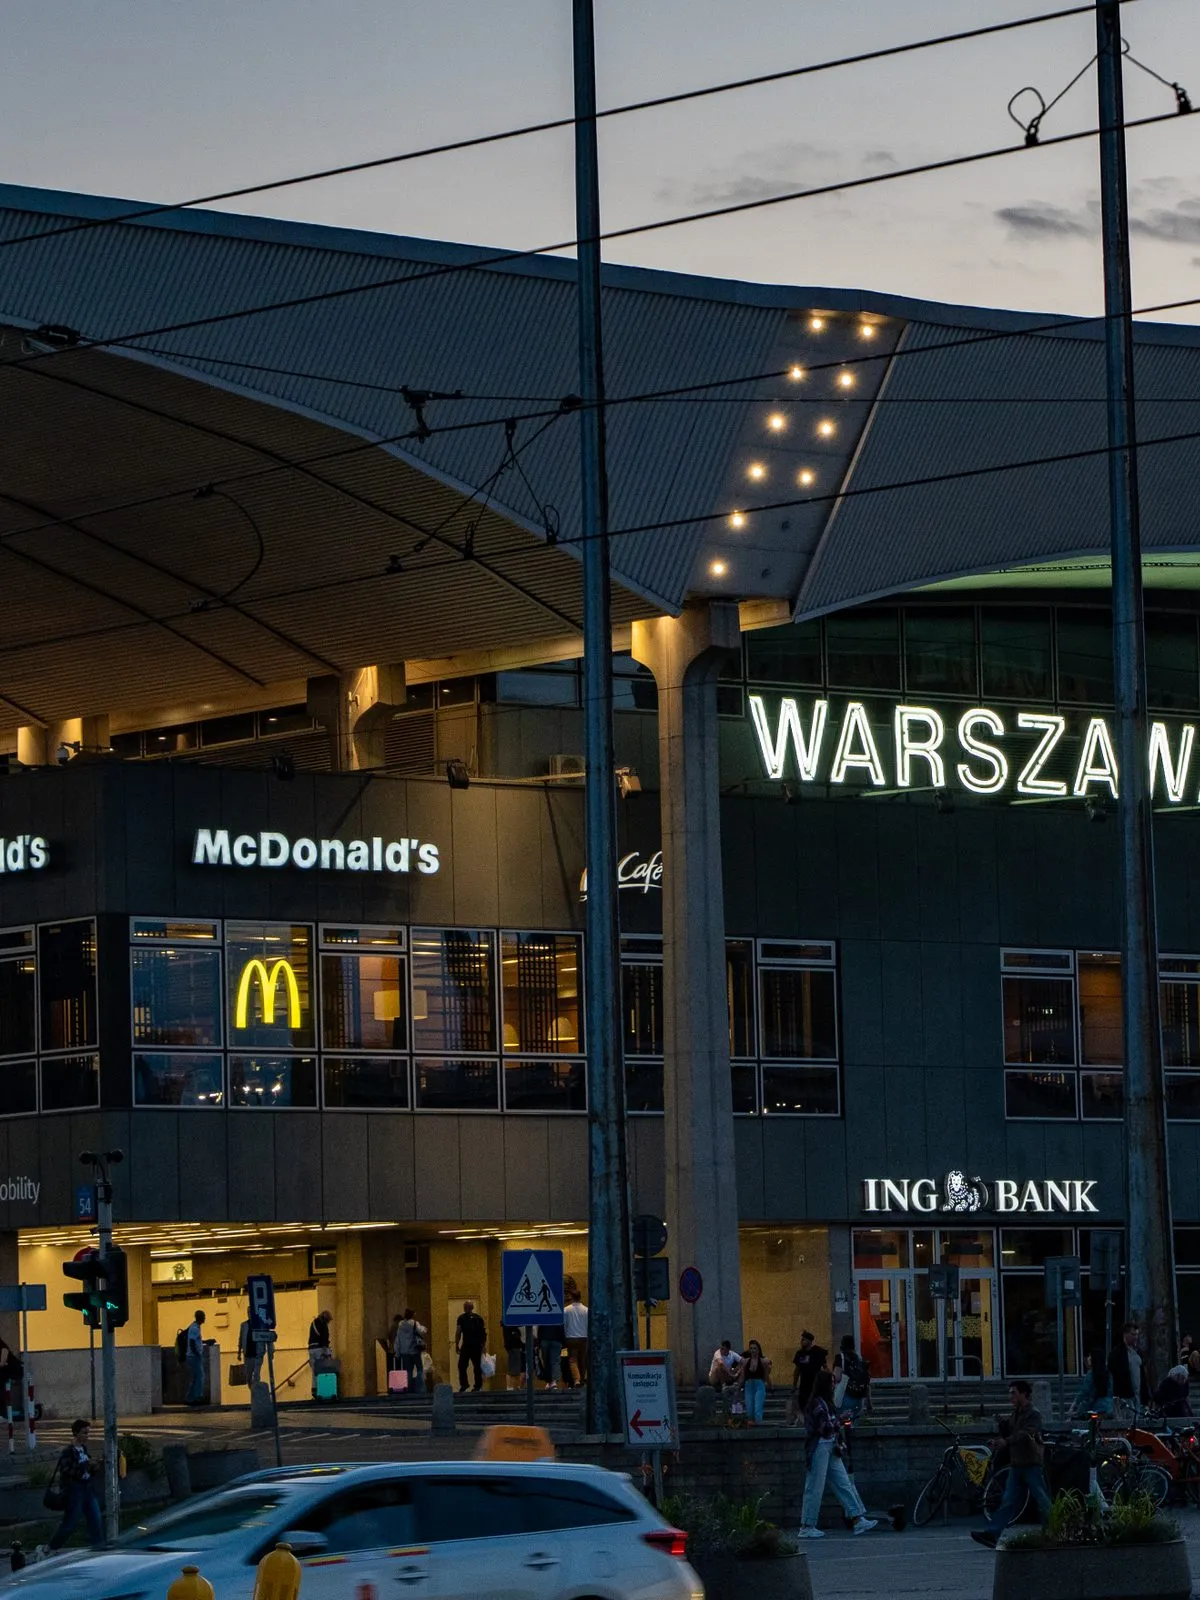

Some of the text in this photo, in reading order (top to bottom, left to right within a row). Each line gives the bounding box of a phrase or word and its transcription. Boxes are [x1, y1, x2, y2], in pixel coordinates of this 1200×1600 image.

[193, 828, 440, 875] McDonald's
[79, 1197, 92, 1214] 54
[863, 1177, 1099, 1213] ING BANK
